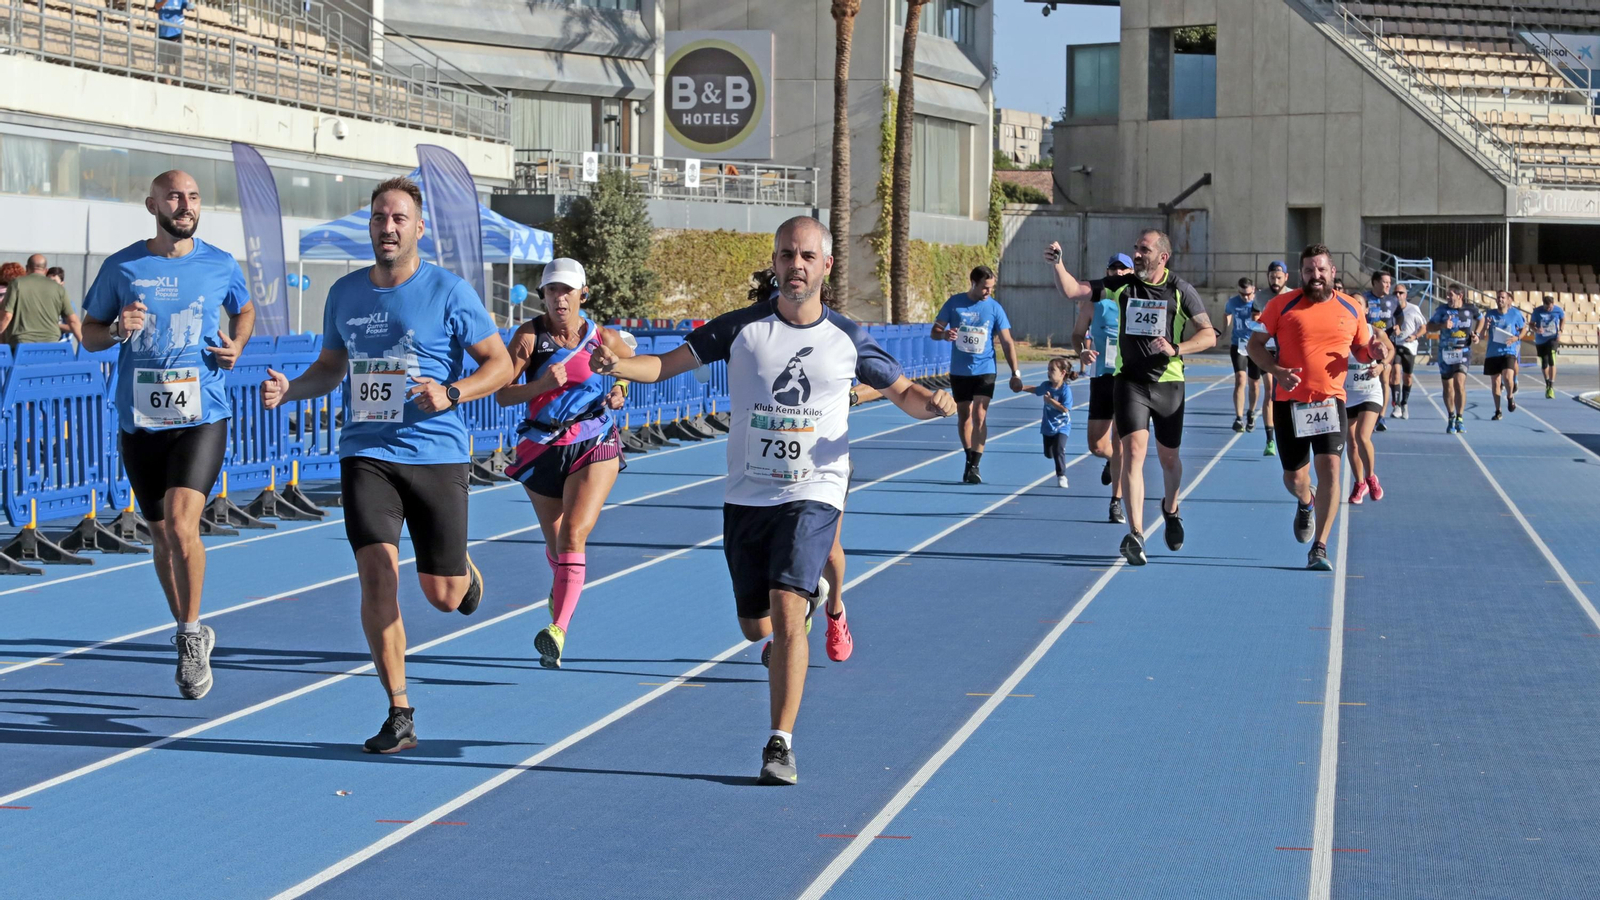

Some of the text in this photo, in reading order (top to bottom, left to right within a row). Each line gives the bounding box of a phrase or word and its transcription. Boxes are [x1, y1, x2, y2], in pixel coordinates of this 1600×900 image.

[672, 76, 752, 109] B&B
[682, 113, 740, 125] HOTELS
[156, 277, 178, 287] XLI
[369, 312, 388, 323] XLI
[1135, 312, 1158, 324] 245
[963, 336, 979, 344] 369
[360, 382, 392, 401] 965
[150, 390, 187, 408] 674
[754, 403, 823, 416] Klub Kema Kilos
[1306, 412, 1329, 424] 244
[761, 438, 801, 459] 739
